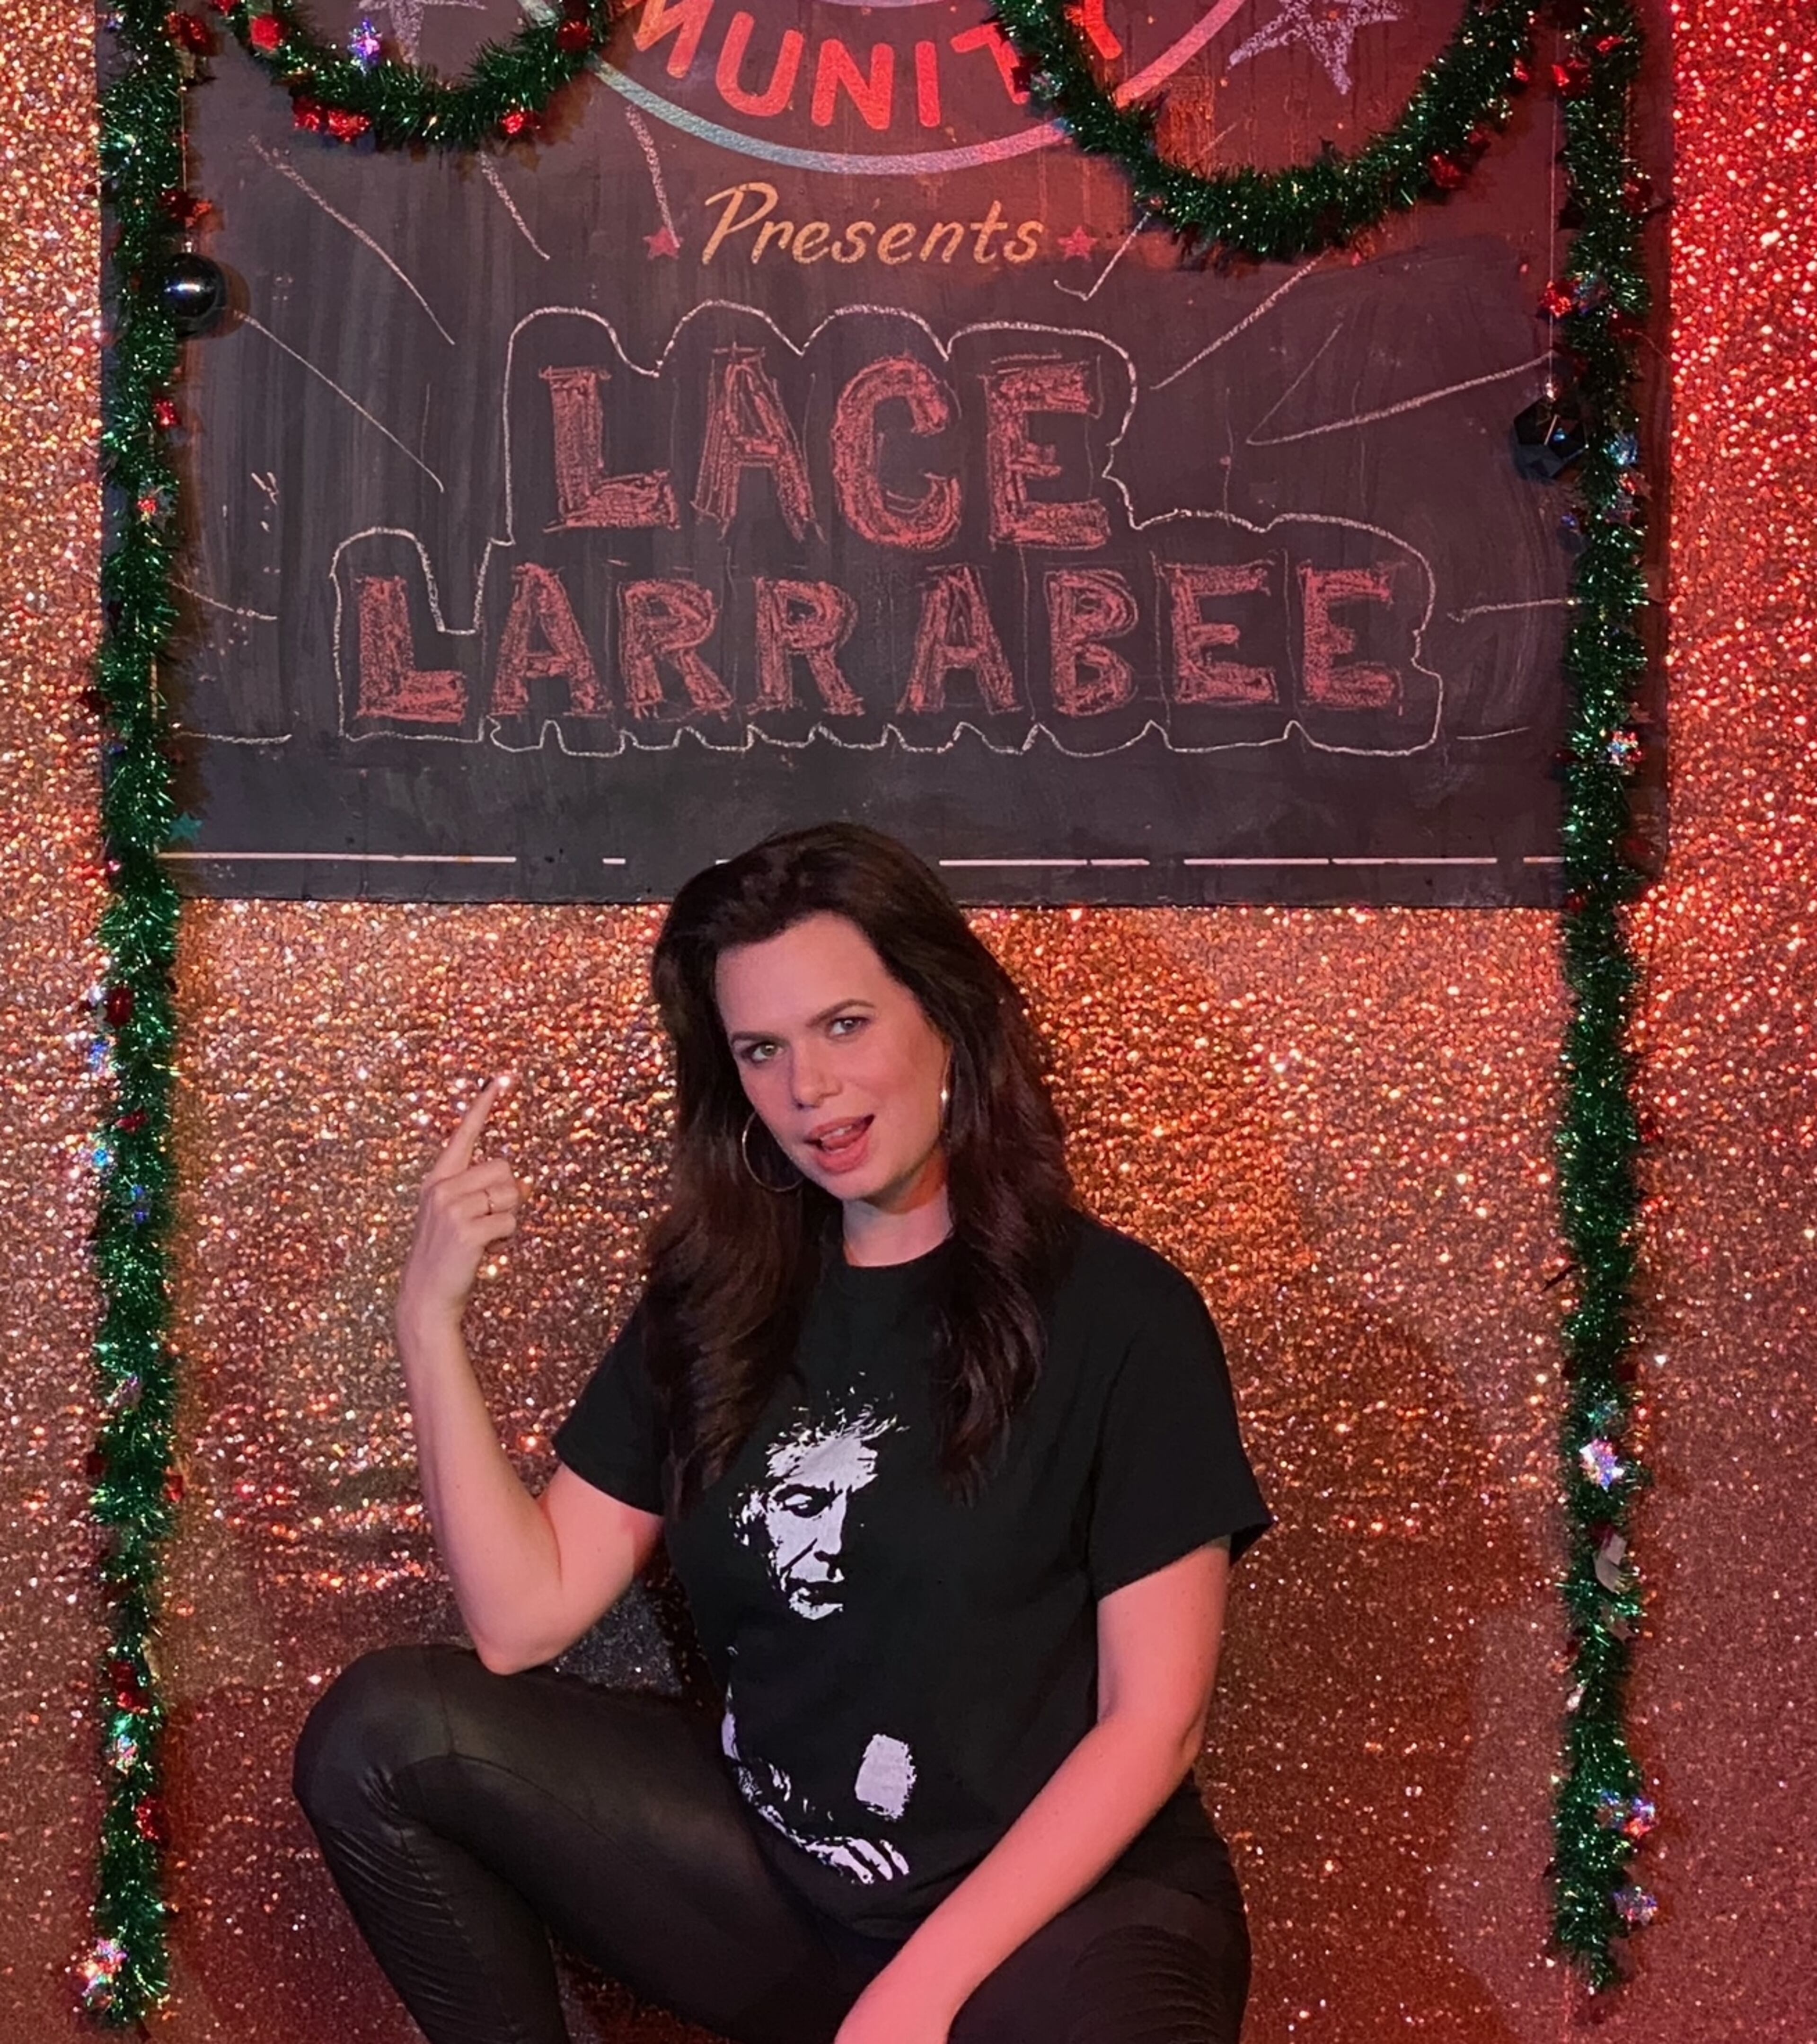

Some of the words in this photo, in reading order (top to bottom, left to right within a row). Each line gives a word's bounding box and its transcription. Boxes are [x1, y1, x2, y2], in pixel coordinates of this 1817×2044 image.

[702, 182, 1045, 265] Presents
[538, 342, 1111, 552] LACE
[354, 562, 1403, 724] LARRABEE
